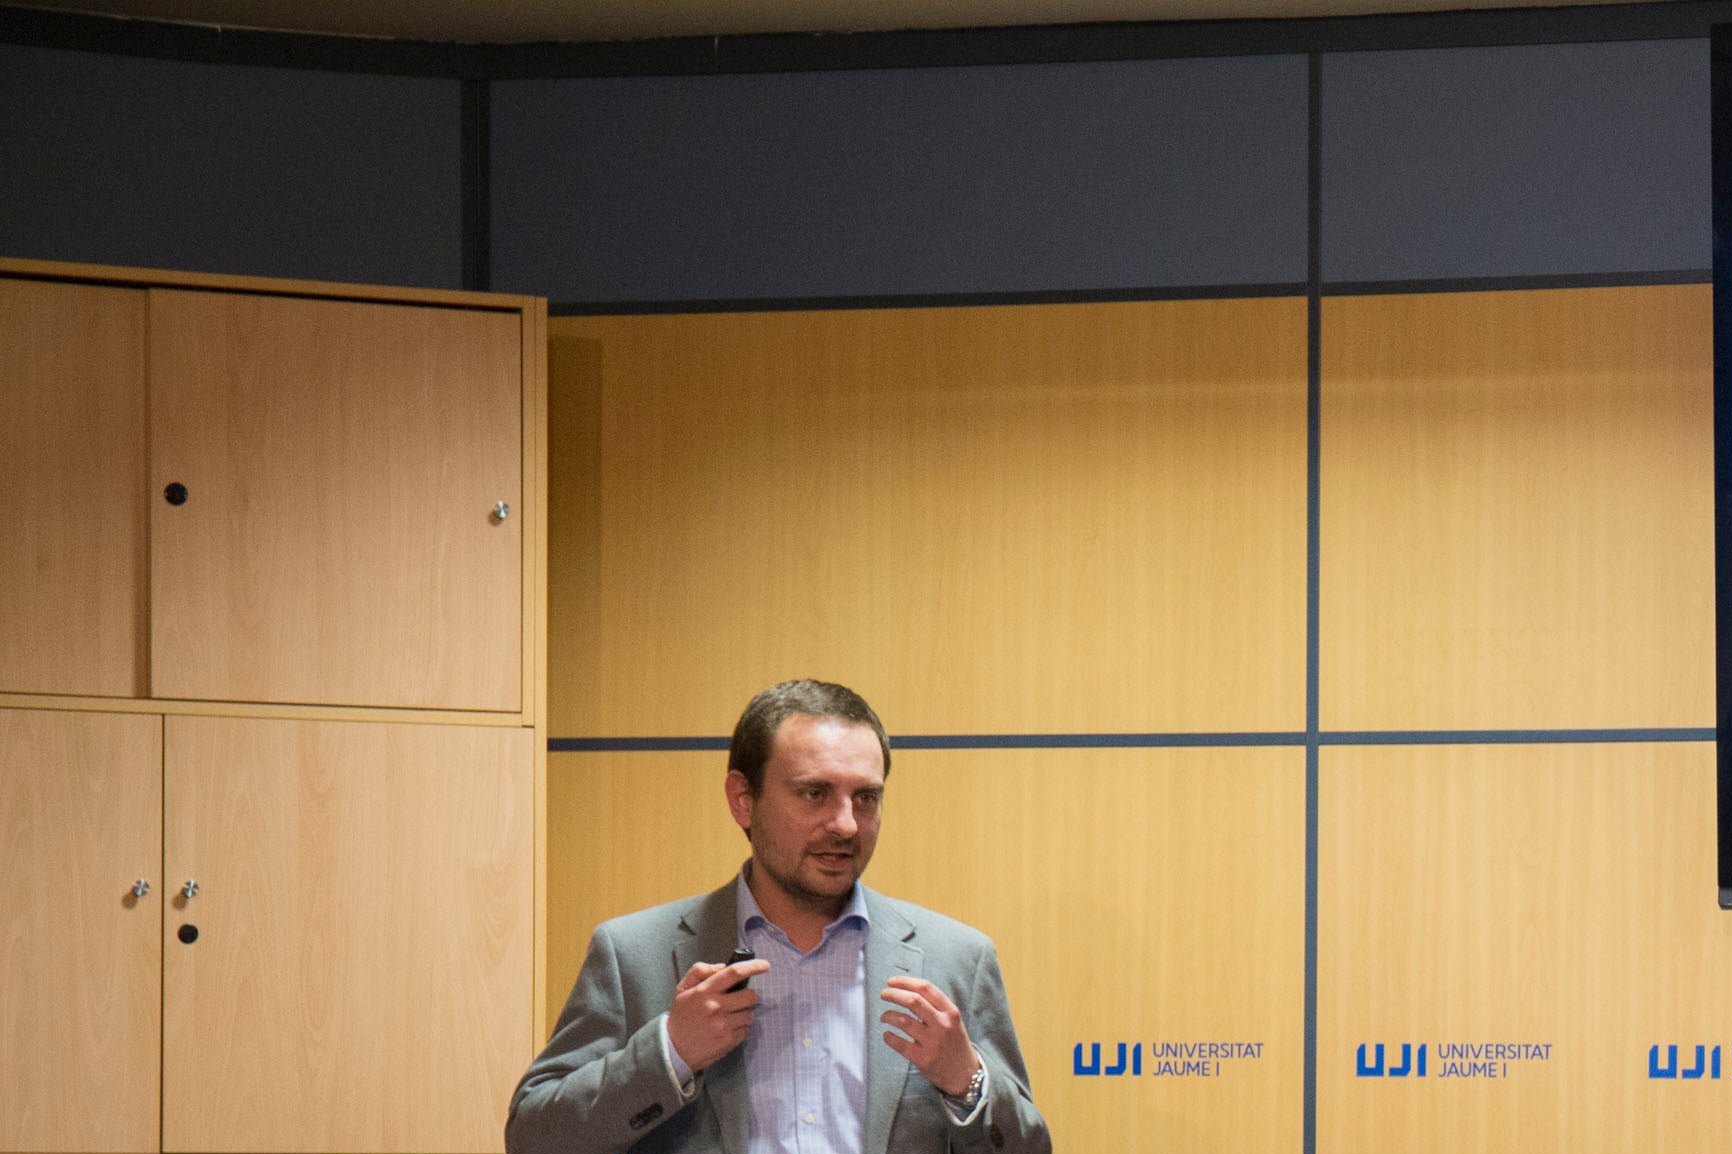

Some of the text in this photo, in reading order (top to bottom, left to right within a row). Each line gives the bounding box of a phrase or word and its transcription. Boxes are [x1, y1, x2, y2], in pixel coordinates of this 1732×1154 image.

[1153, 1042, 1264, 1058] UNIVERSITAT
[1439, 1043, 1552, 1060] UNIVERSITAT
[1073, 1043, 1141, 1076] UJI
[1356, 1043, 1426, 1077] UJI
[1649, 1045, 1721, 1079] UJI
[1153, 1061, 1219, 1076] JAUME I
[1438, 1062, 1506, 1078] JAUME I
